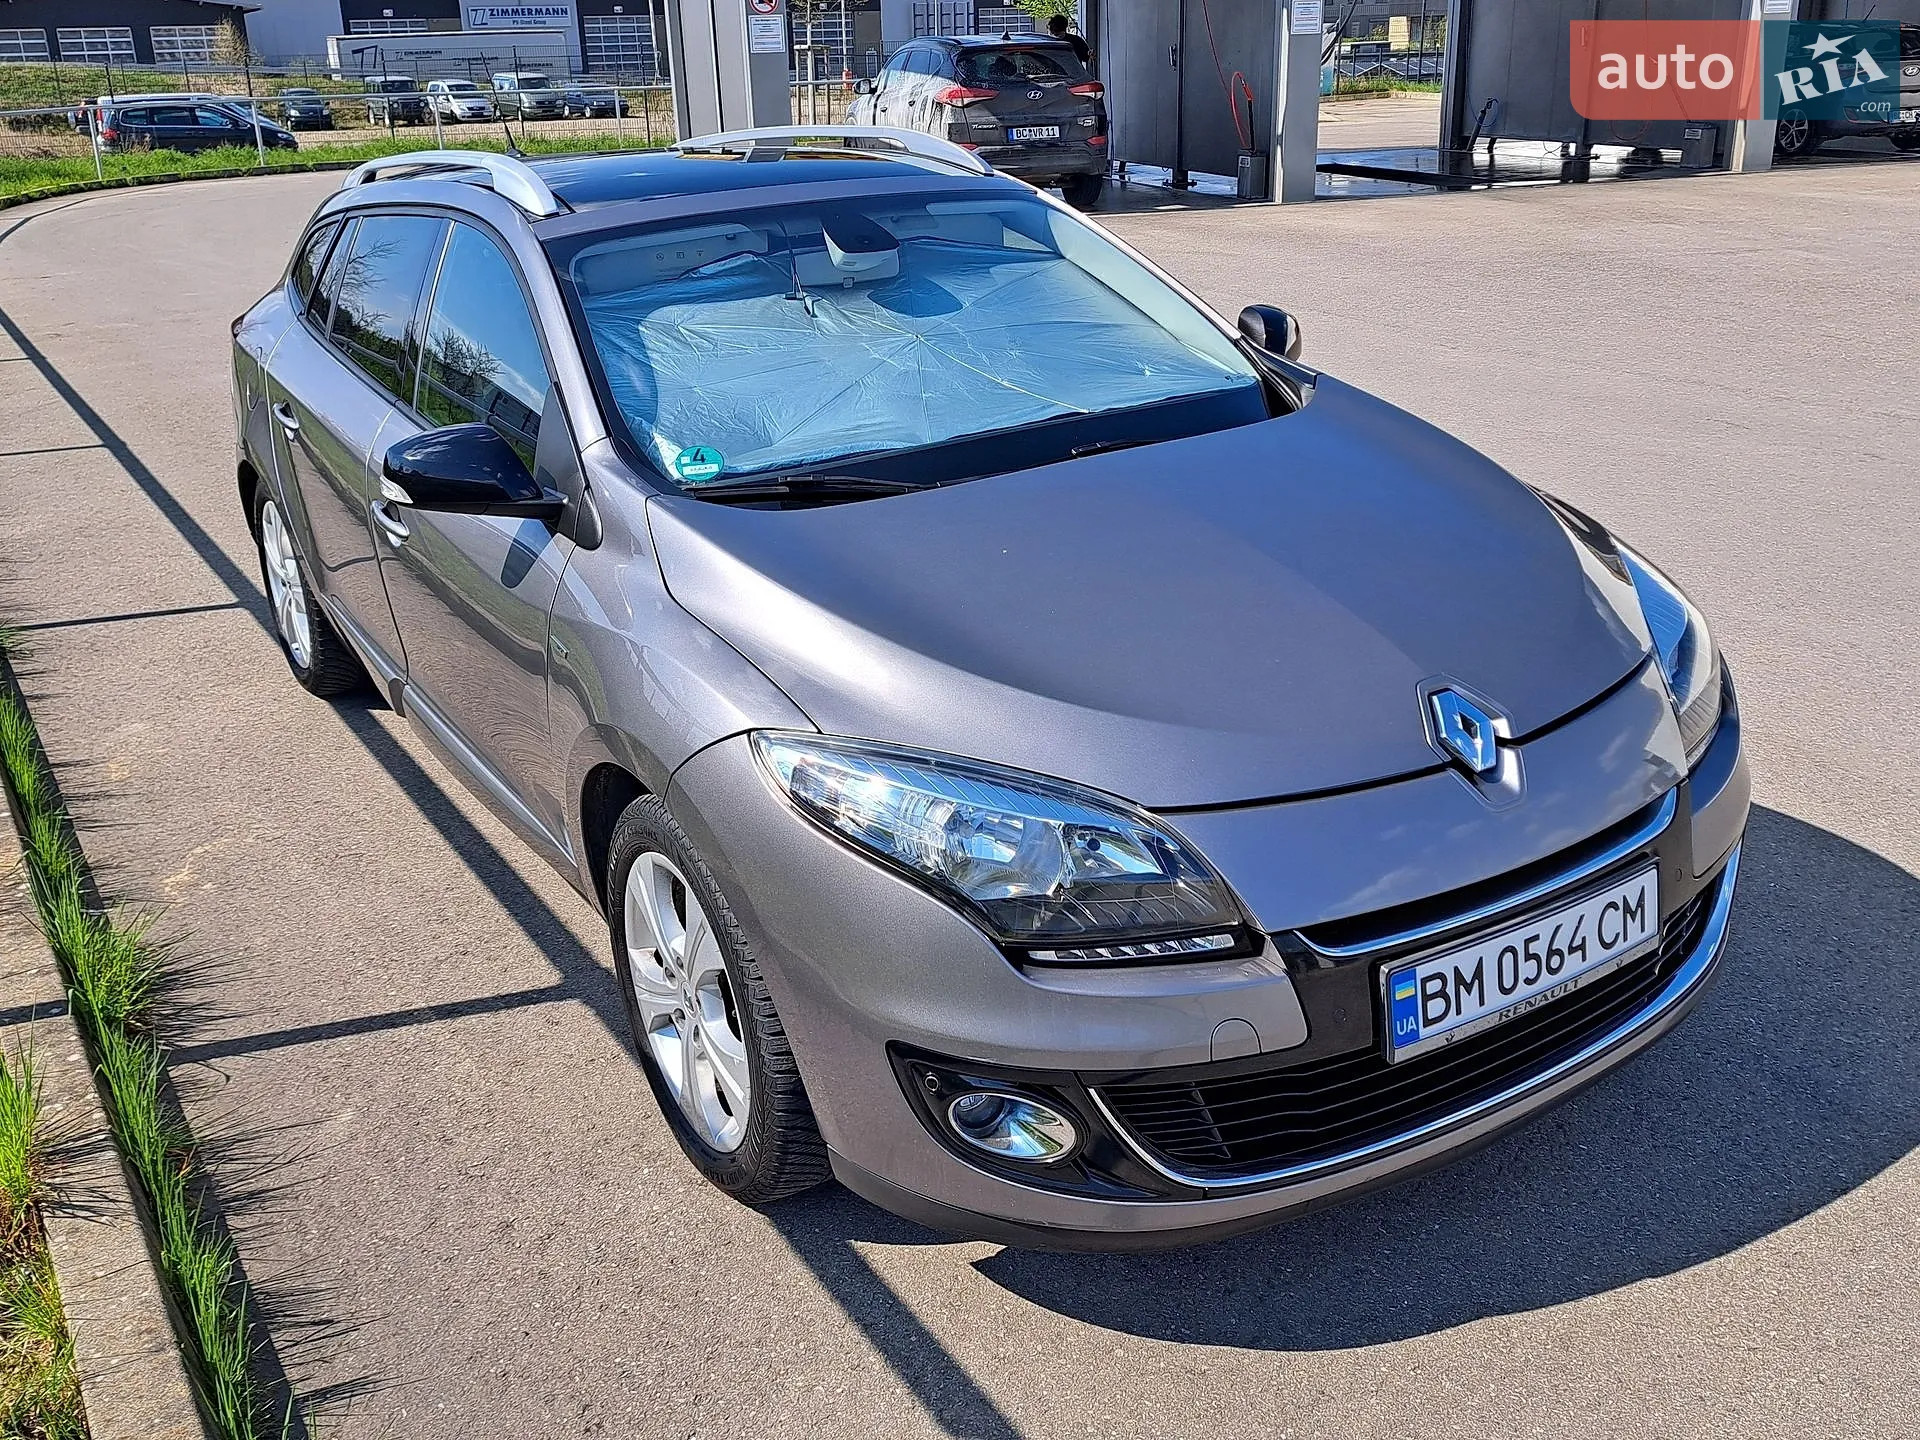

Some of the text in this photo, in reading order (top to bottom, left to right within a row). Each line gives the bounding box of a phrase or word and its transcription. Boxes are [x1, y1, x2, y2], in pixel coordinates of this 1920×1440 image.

[489, 7, 568, 17] ZIMMERMANN
[692, 447, 706, 463] 4
[1420, 885, 1646, 1028] BM 0564 CM
[1498, 977, 1582, 1023] RENAULT
[1396, 1015, 1417, 1036] UA
